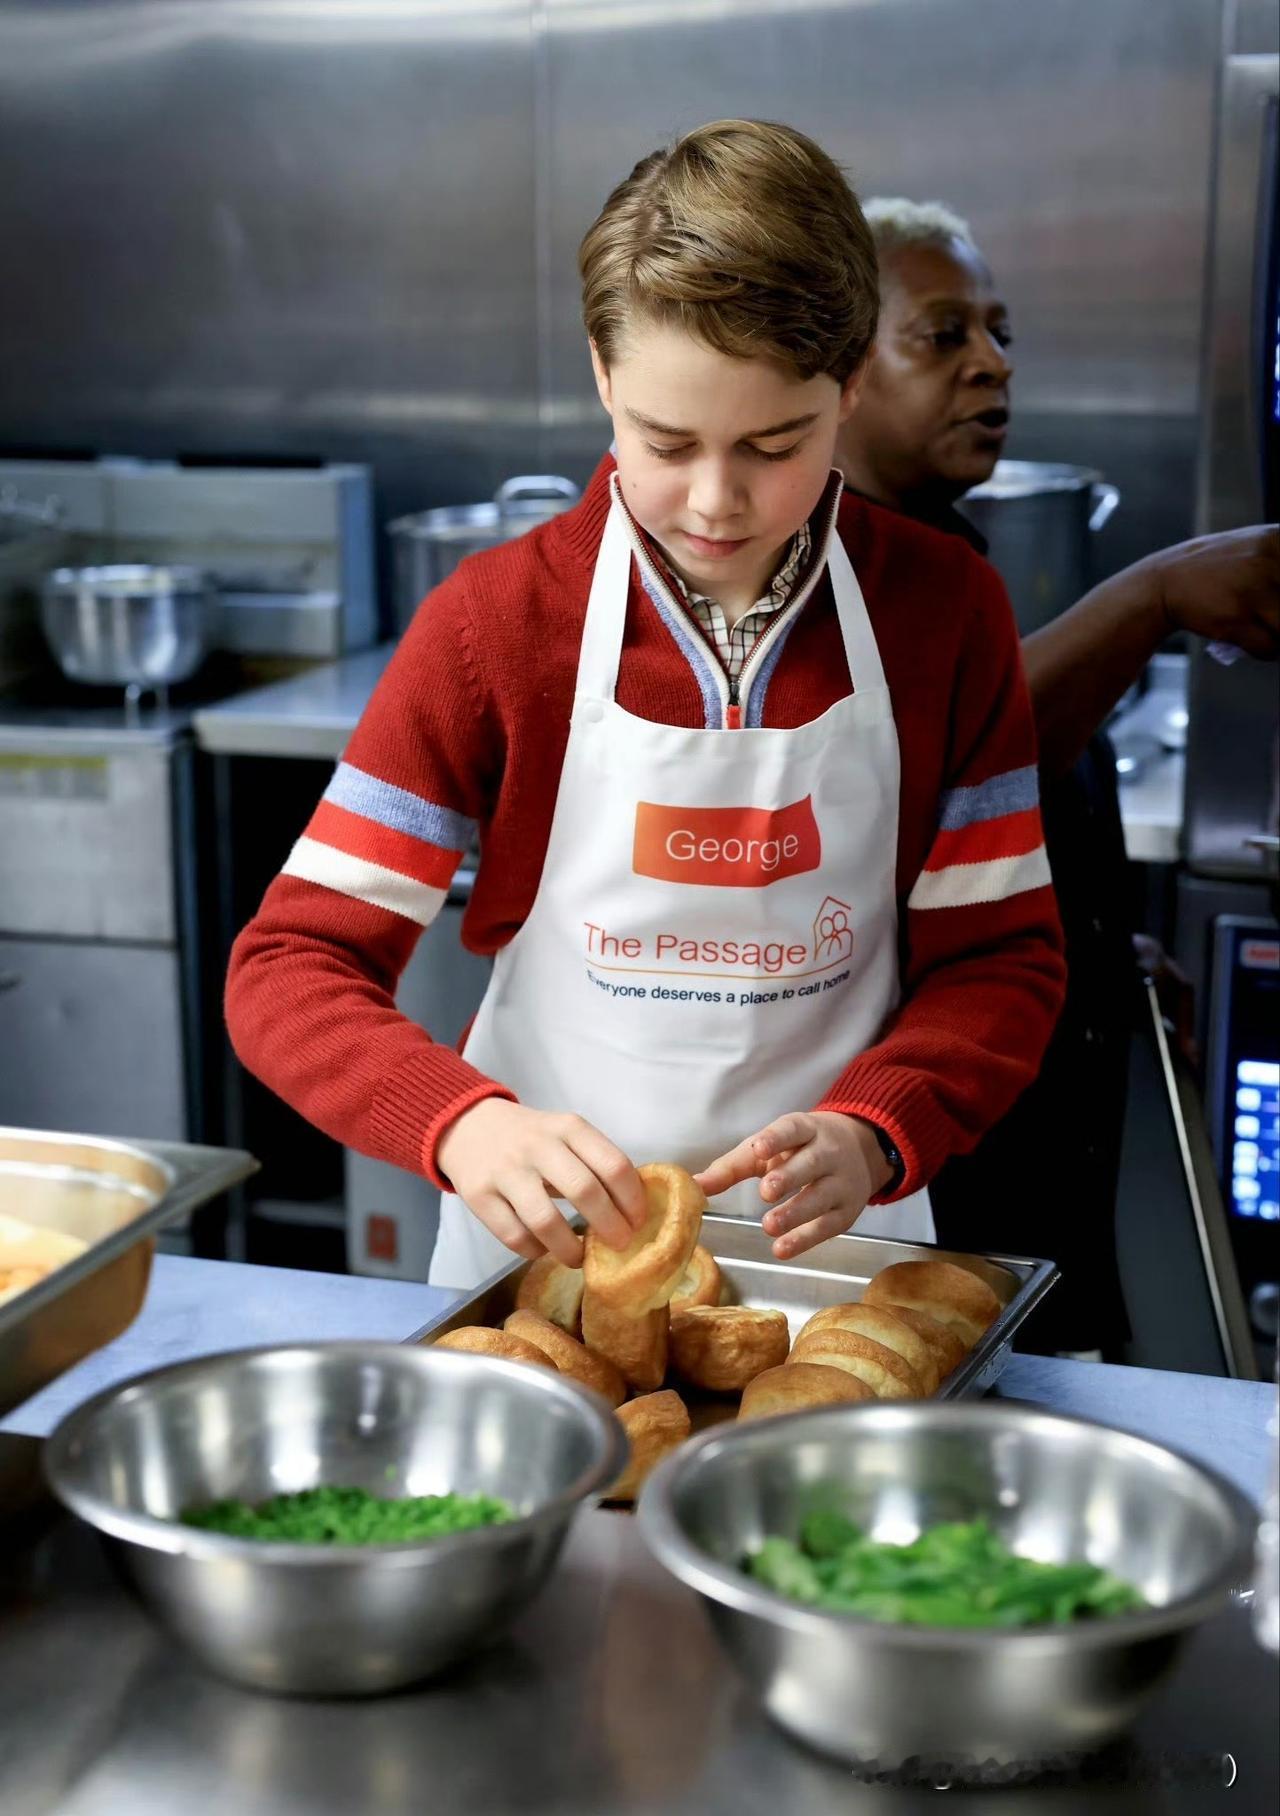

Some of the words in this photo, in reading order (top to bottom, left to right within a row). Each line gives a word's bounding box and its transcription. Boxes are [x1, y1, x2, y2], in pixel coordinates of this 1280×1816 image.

[666, 830, 799, 871] George
[584, 922, 642, 958] The
[656, 934, 807, 973] Passage
[651, 986, 721, 1003] deserves
[726, 992, 735, 1004] a
[740, 991, 778, 1006] place
[782, 989, 794, 999] to
[798, 982, 821, 996] call
[823, 970, 850, 991] home
